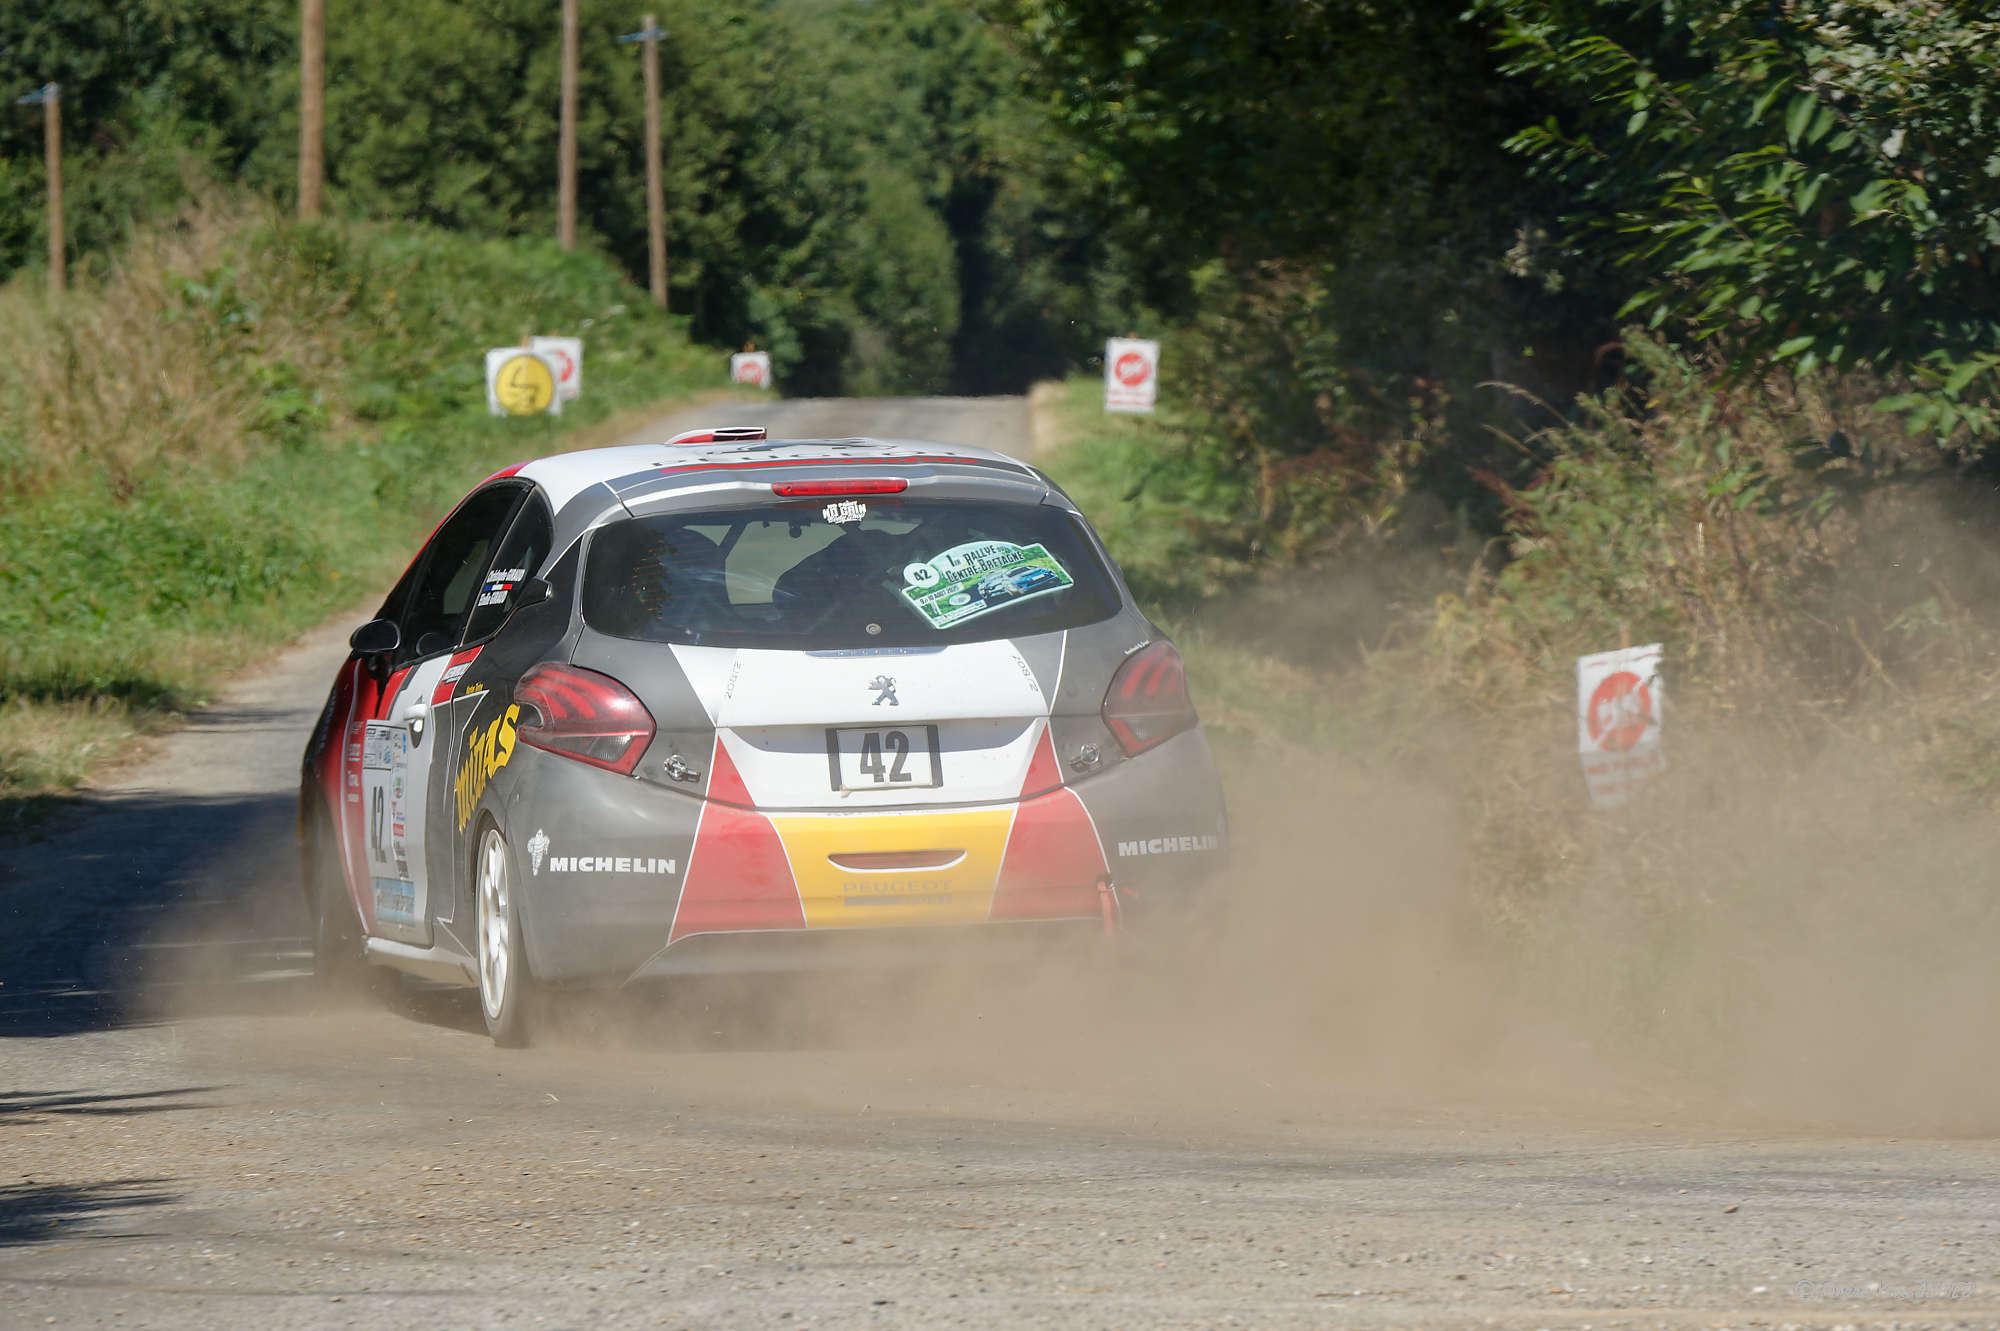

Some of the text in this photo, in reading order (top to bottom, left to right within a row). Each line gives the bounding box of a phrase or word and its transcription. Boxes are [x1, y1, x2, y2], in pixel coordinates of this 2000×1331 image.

[963, 545, 997, 566] RALLYE
[913, 568, 931, 582] 42
[945, 551, 1024, 583] CENTRE-BRETAGNE
[860, 730, 912, 783] 42
[1117, 835, 1218, 857] MICHELIN
[550, 857, 676, 875] MICHELIN
[843, 880, 952, 895] PEUGEOT
